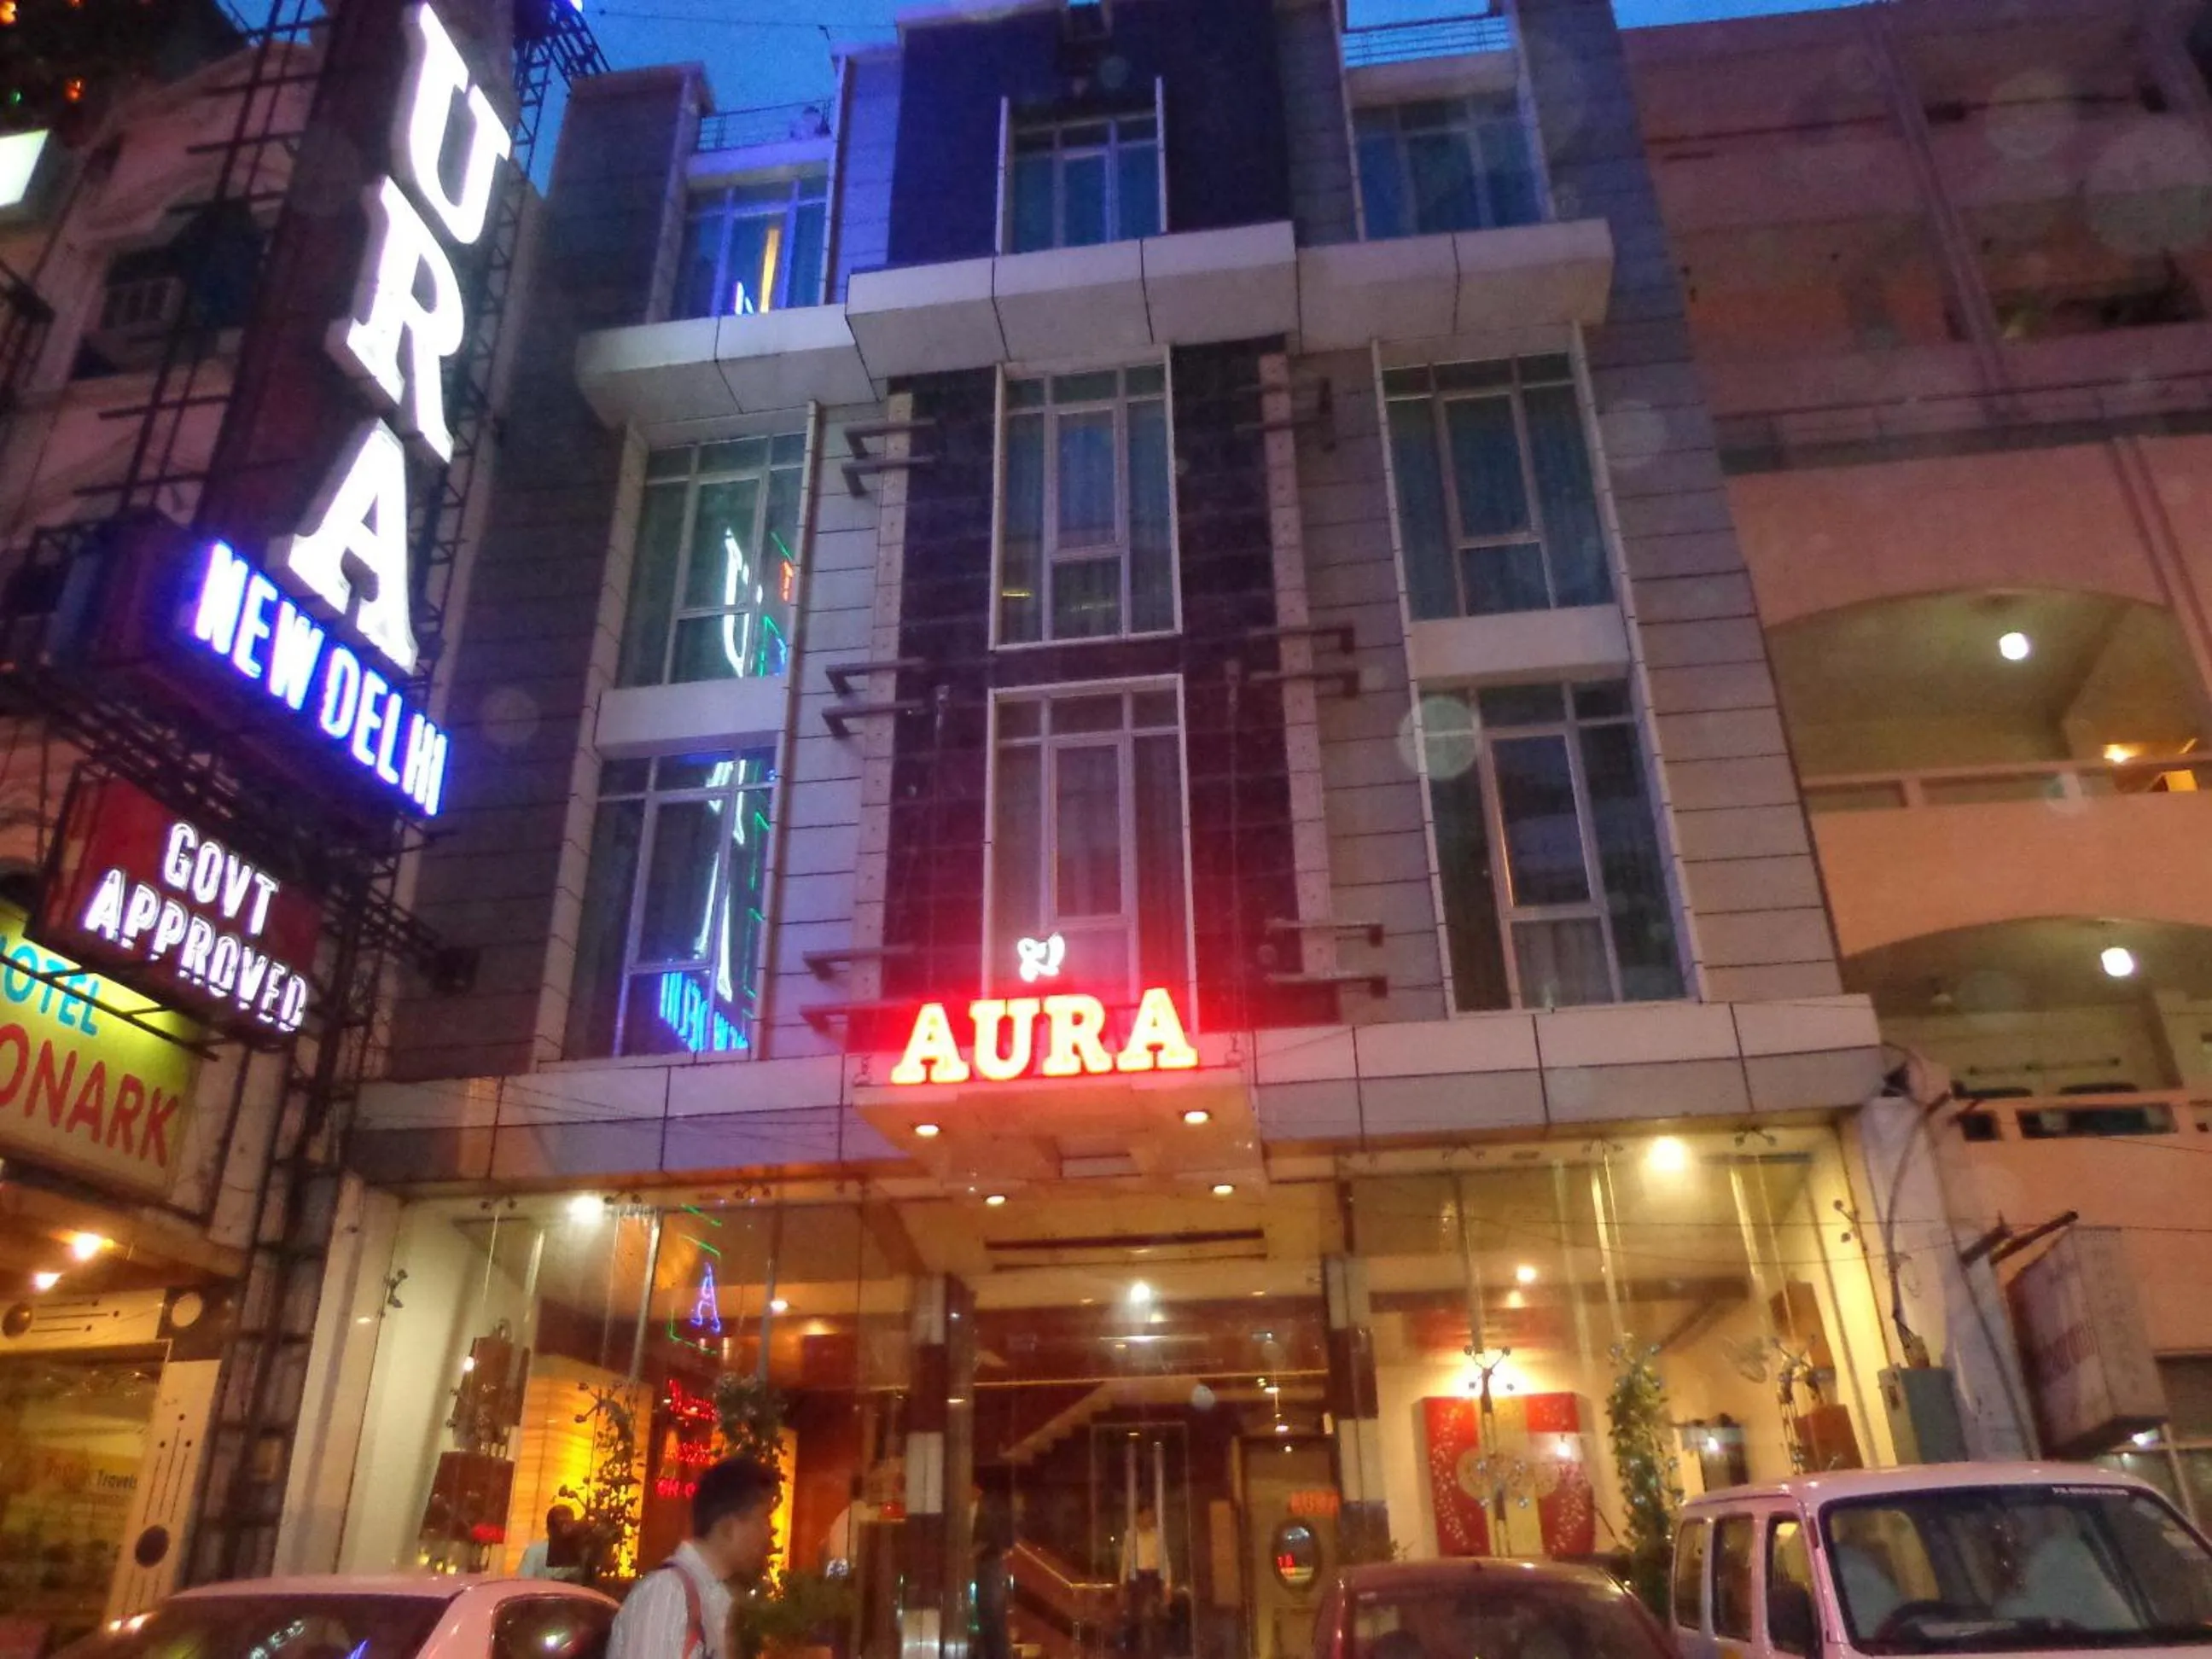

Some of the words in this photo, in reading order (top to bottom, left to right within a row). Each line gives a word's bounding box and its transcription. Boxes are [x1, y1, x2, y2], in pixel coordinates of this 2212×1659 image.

[195, 539, 324, 710] NEW
[319, 644, 449, 817] DELHI
[164, 822, 281, 936] GOVT
[0, 935, 98, 1037] OTEL
[83, 868, 307, 1033] APPROVED
[890, 987, 1199, 1086] AURA
